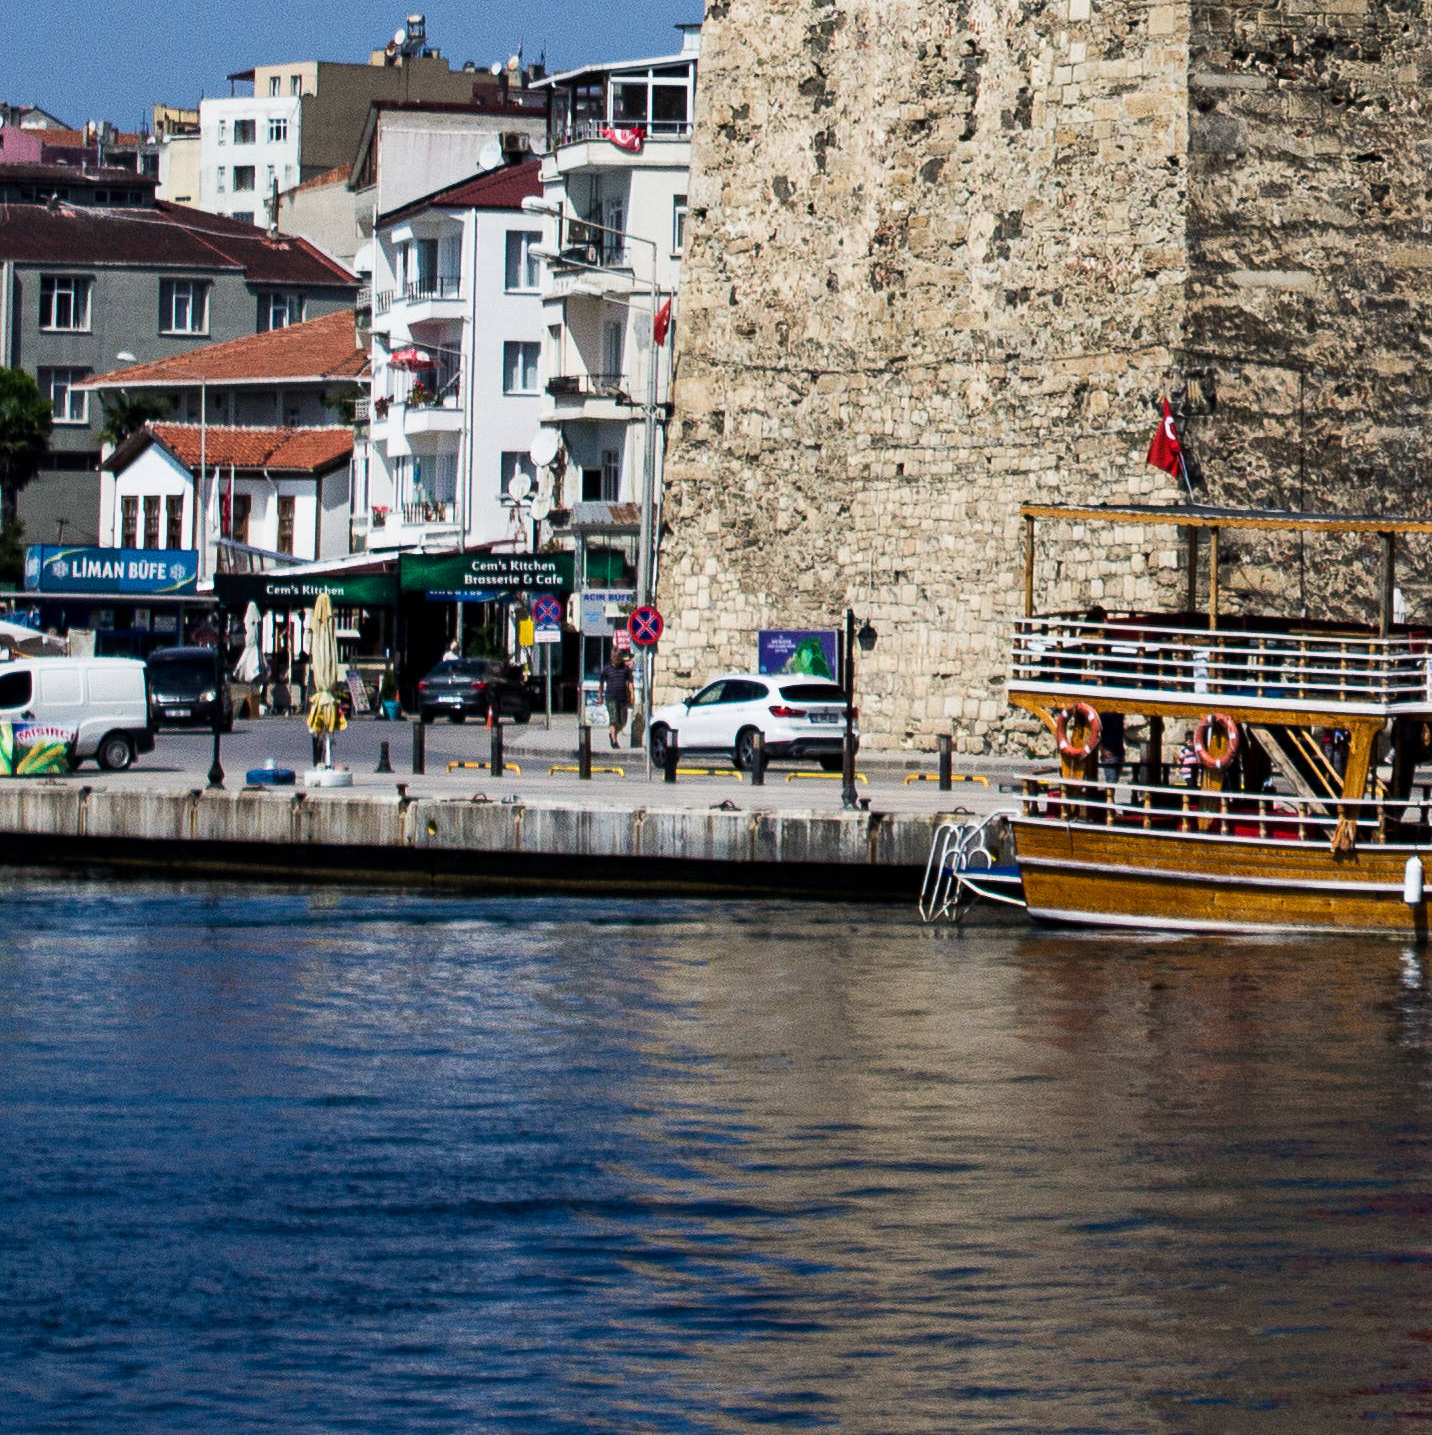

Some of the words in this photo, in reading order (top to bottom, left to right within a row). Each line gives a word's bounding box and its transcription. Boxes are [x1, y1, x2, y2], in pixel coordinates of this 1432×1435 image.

[72, 556, 125, 578] LİMAN
[128, 559, 167, 580] BÜFE
[471, 559, 507, 571] Cem's
[510, 559, 556, 571] Kitchen
[464, 573, 520, 585] Brasserie
[536, 573, 563, 585] Cafe
[266, 584, 299, 595] Cem's
[302, 584, 345, 596] Kitchen
